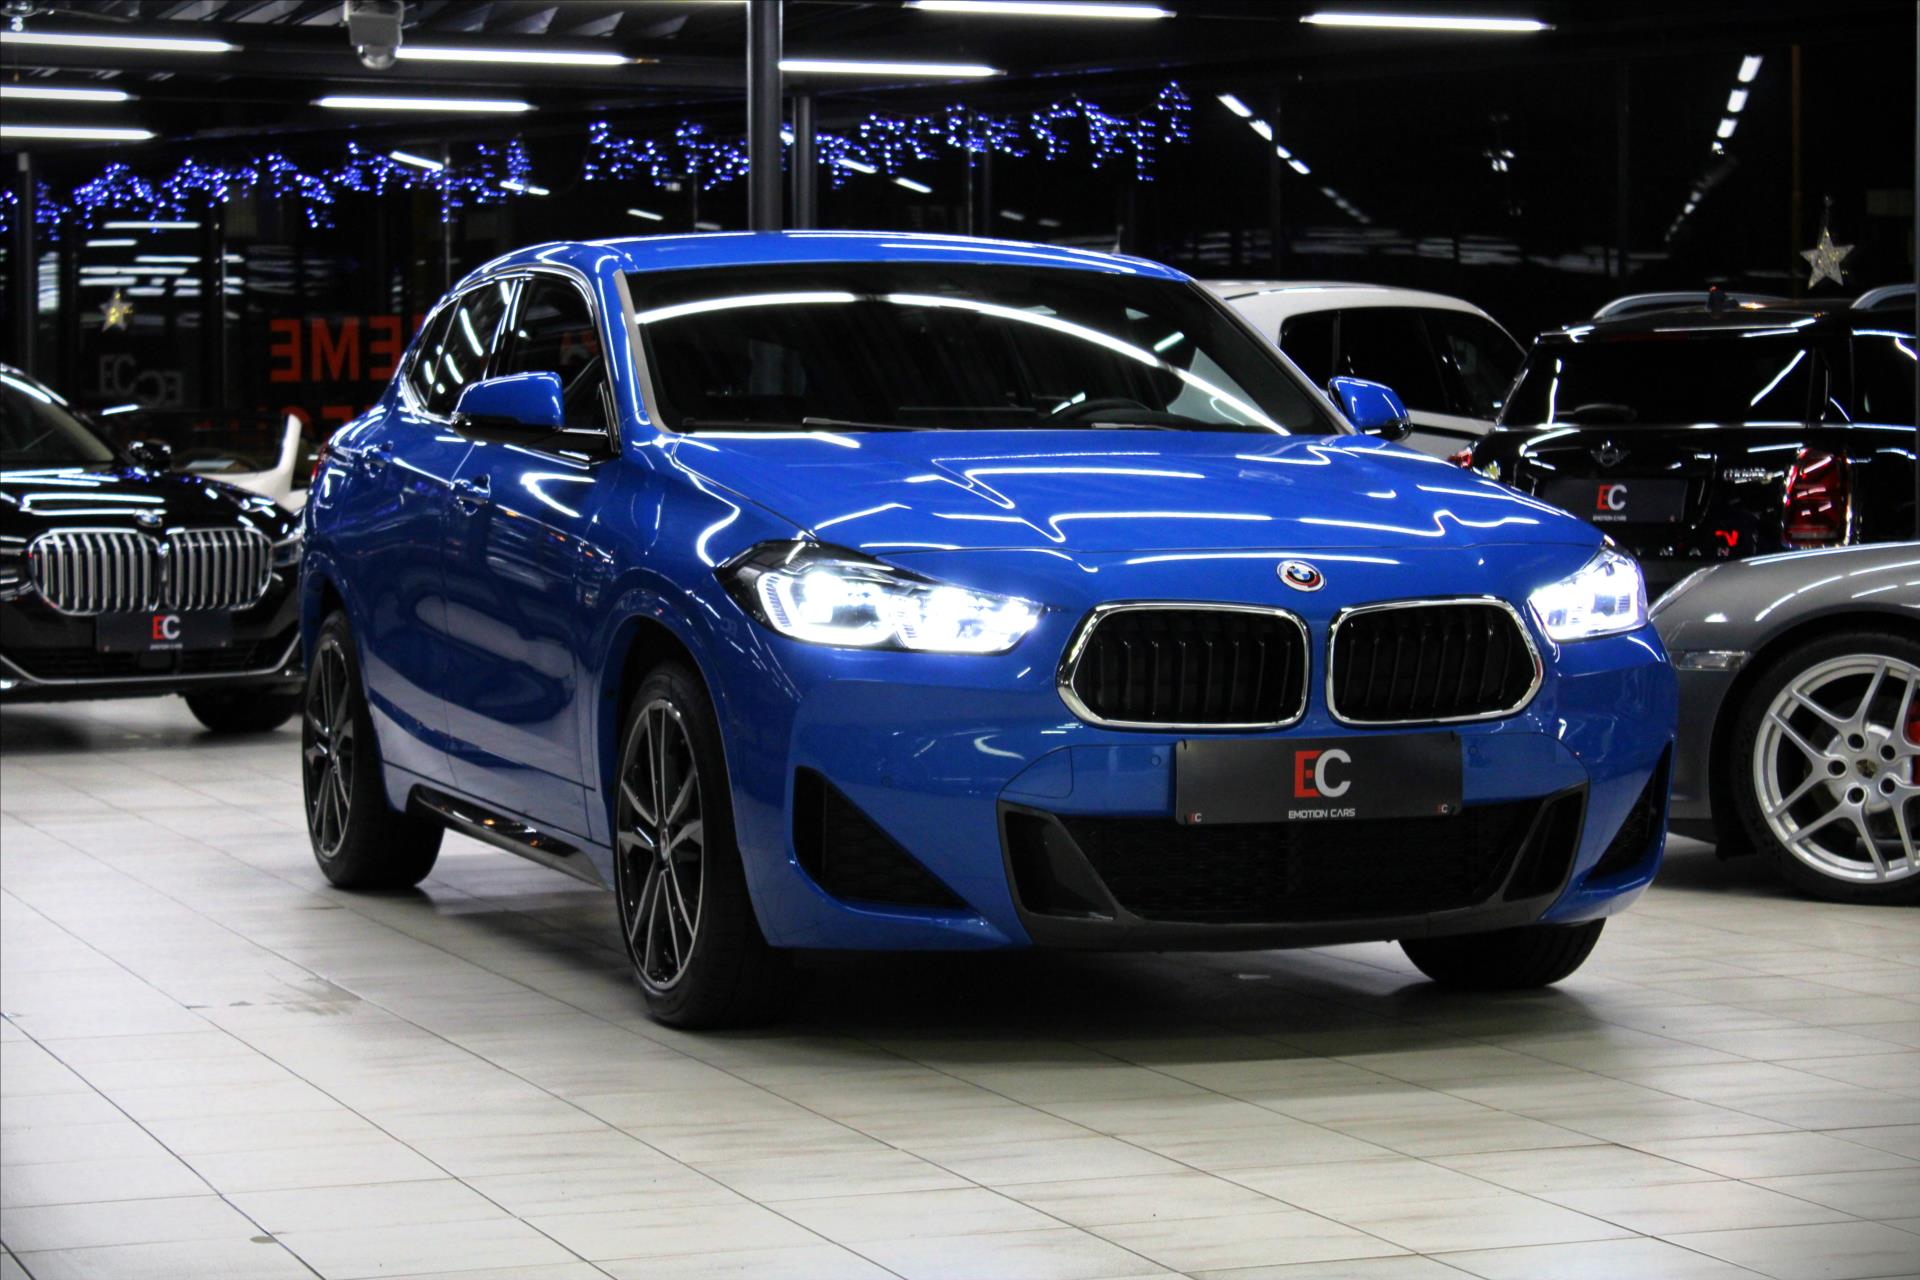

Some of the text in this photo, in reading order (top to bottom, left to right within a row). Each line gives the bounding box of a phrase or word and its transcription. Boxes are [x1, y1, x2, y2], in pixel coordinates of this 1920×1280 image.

[1596, 484, 1628, 511] EC
[153, 614, 181, 640] EC
[1294, 748, 1352, 798] EC
[1288, 808, 1356, 819] EMOTION CARS
